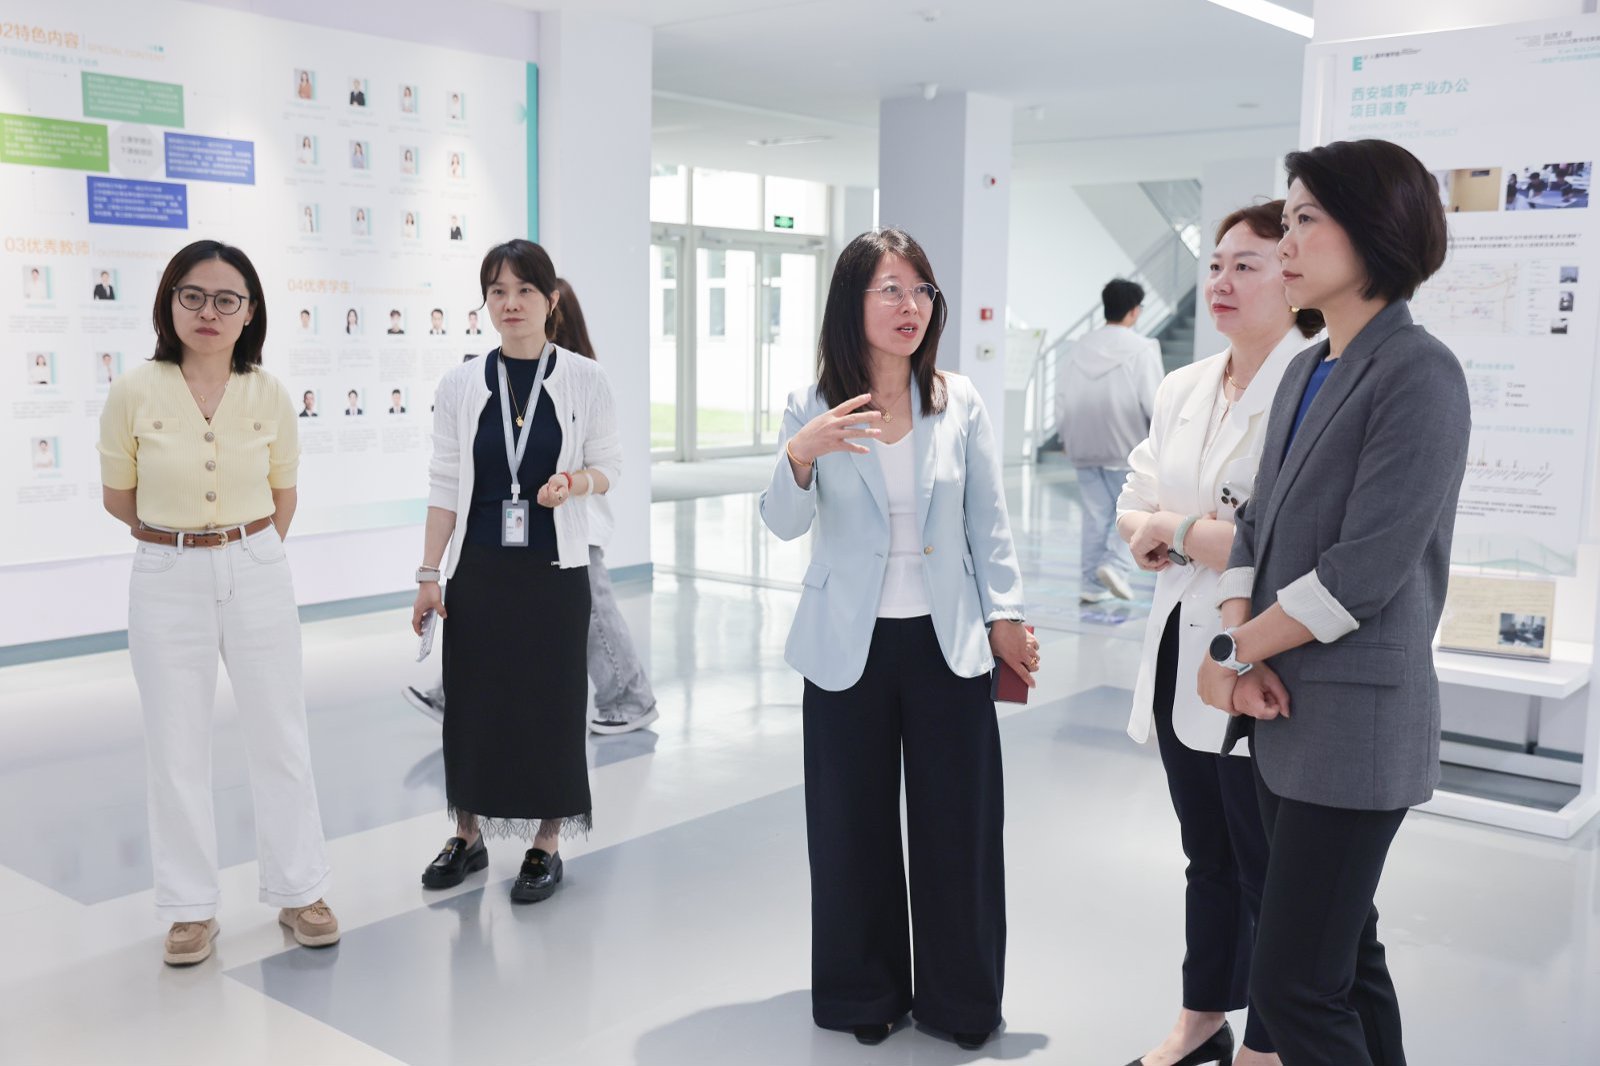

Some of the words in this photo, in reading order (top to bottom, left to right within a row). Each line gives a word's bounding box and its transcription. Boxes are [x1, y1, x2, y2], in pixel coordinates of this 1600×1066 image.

[1351, 78, 1470, 102] 西安城南产业办公
[1350, 101, 1408, 118] 项目调查
[5, 237, 90, 256] 03优秀教师
[287, 278, 352, 295] 04优秀学生
